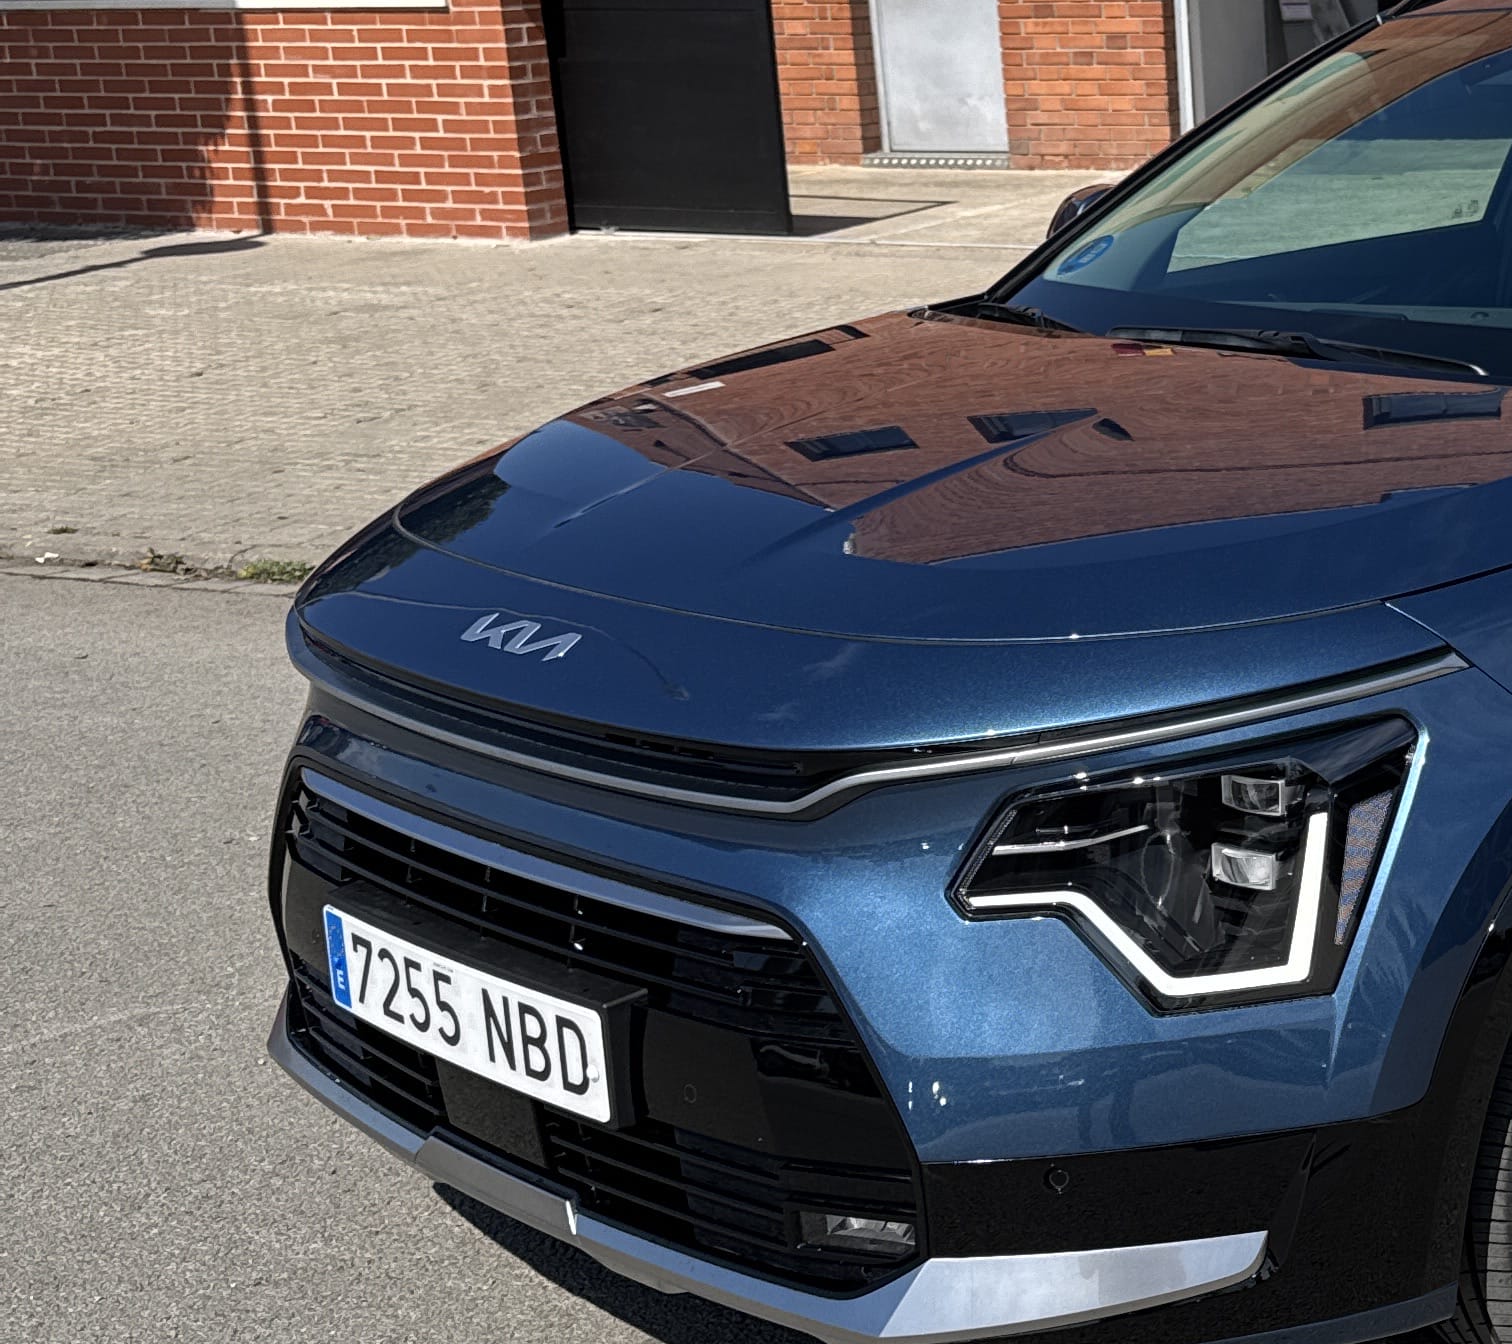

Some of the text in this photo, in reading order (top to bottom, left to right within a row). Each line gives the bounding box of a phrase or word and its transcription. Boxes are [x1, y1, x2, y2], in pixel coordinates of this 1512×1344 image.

[460, 612, 582, 662] KIA
[336, 932, 590, 1096] E 7255 NBD
